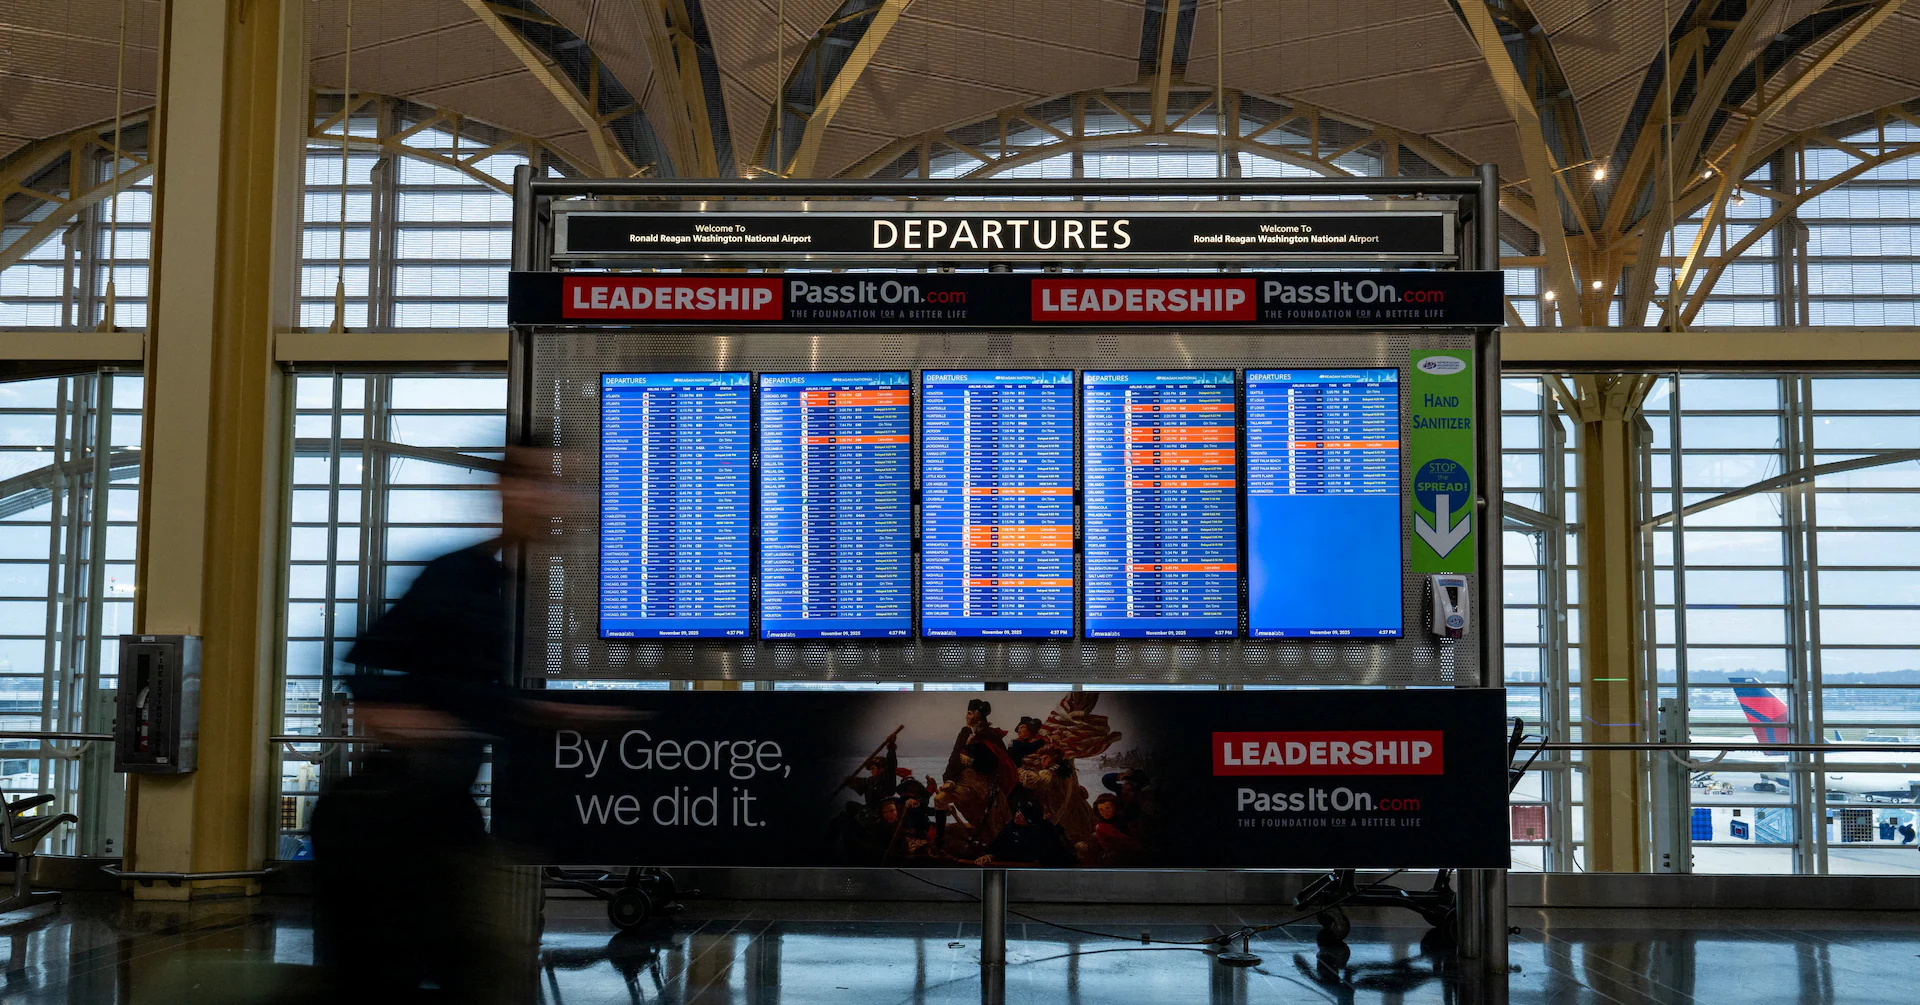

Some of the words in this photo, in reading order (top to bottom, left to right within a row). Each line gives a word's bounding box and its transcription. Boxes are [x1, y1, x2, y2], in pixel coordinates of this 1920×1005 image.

[695, 224, 733, 233] Welcome
[735, 224, 746, 233] To
[1260, 224, 1299, 233] Welcome
[1301, 225, 1312, 233] To
[630, 234, 658, 243] Ronald
[660, 234, 691, 245] Reagan
[693, 234, 742, 245] Washington
[745, 234, 779, 243] National
[781, 234, 811, 245] Airport
[873, 220, 1131, 249] DEPARTURES
[1193, 234, 1224, 243] Ronald
[1225, 234, 1256, 245] Reagan
[1258, 234, 1309, 245] Washington
[1311, 234, 1347, 243] National
[1348, 234, 1379, 245] Airport
[573, 287, 773, 311] LEADERSHIP
[1042, 288, 1246, 312] LEADERSHIP
[791, 310, 807, 318] THE
[813, 310, 875, 318] FOUNDATION
[881, 309, 895, 318] FOR
[899, 310, 905, 318] A
[910, 310, 943, 318] BETTER
[948, 310, 966, 318] LIFE
[1265, 310, 1282, 318] THE
[1288, 310, 1351, 318] FOUNDATION
[1357, 309, 1371, 318] FOR
[1376, 310, 1382, 318] A
[1386, 310, 1420, 318] BETTER
[1425, 310, 1443, 318] LIFE
[764, 377, 805, 385] DEPARTURES
[927, 374, 967, 382] DEPARTURES
[1088, 375, 1128, 383] DEPARTURES
[1424, 393, 1459, 408] HAND
[1413, 414, 1471, 430] SANITIZER
[1429, 462, 1457, 473] STOP
[1417, 482, 1468, 492] SPREAD!
[555, 729, 609, 779] By
[620, 729, 791, 780] George,
[1223, 740, 1433, 766] LEADERSHIP
[575, 795, 640, 826] we
[653, 786, 718, 827] did
[732, 786, 767, 827] it.
[1238, 818, 1256, 827] THE
[1261, 818, 1327, 827] FOUNDATION
[1331, 817, 1347, 827] FOR
[1350, 818, 1357, 827] A
[1361, 818, 1396, 827] BETTER
[1401, 818, 1421, 827] LIFE
